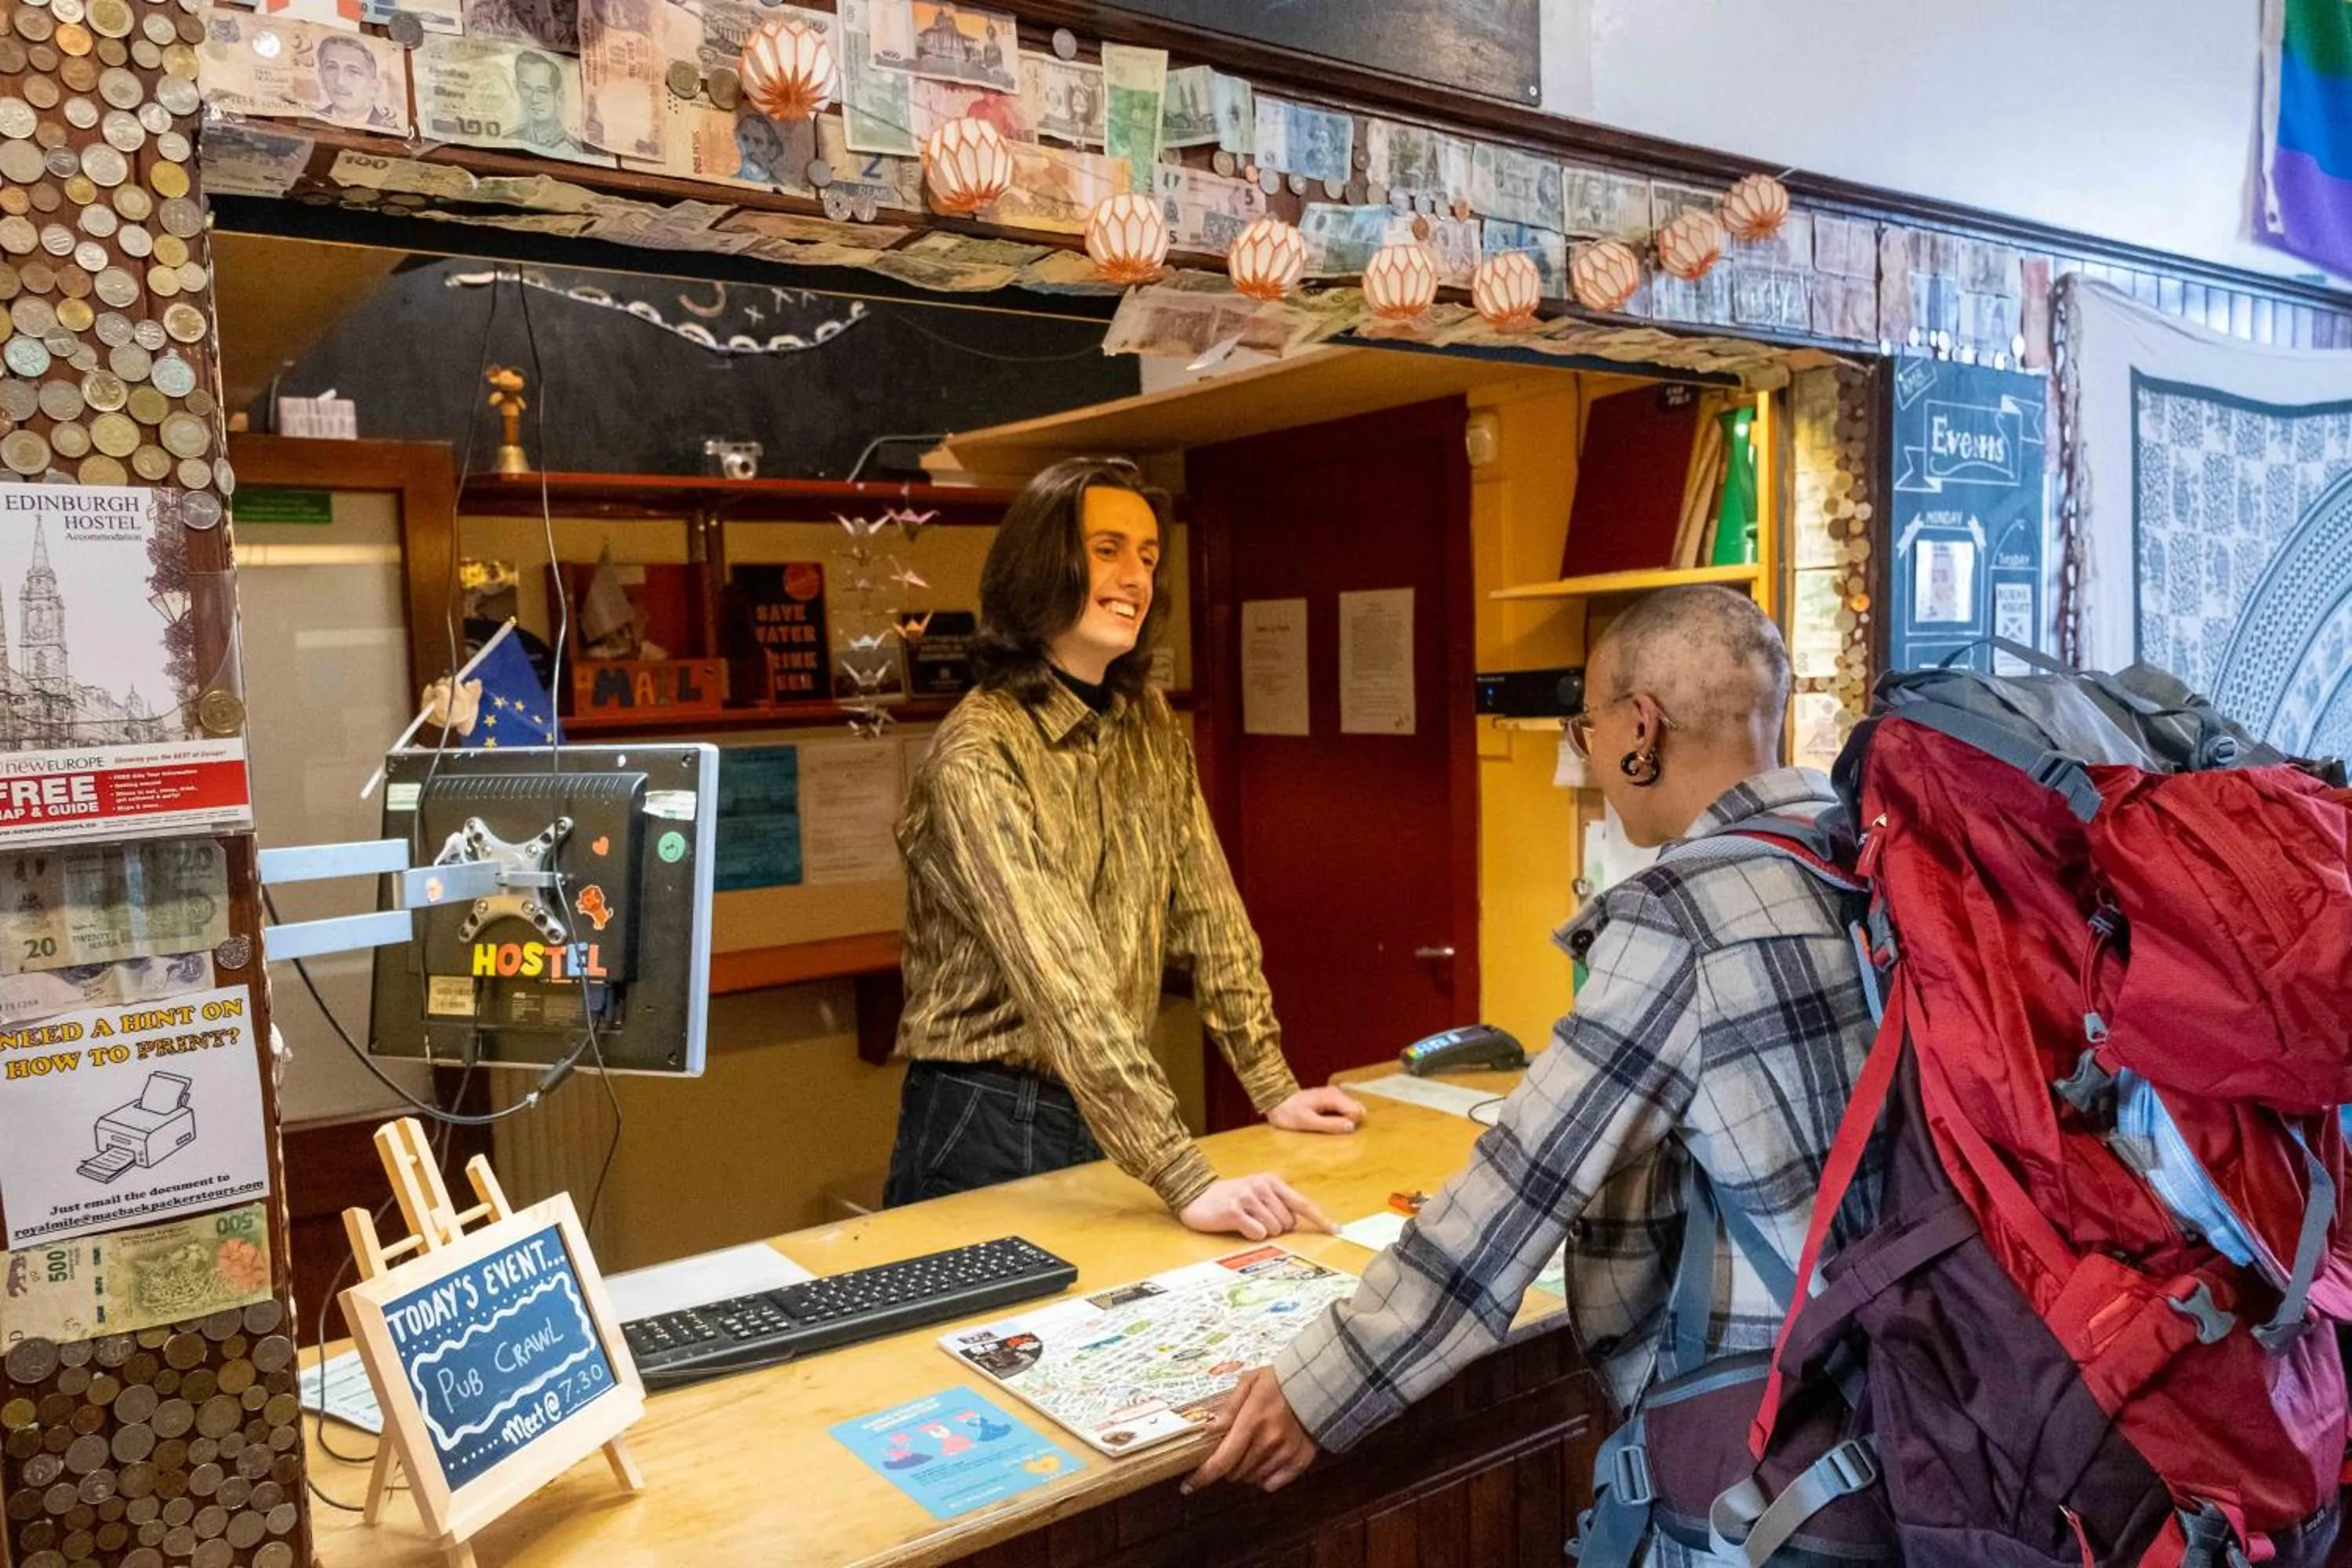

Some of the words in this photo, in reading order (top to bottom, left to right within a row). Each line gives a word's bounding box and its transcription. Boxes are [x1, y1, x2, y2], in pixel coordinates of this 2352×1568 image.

[1932, 414, 2005, 463] Events
[5, 495, 140, 512] EDINBURGH
[64, 515, 141, 530] HOSTEL
[65, 532, 142, 542] Accommodation
[757, 604, 807, 622] SAVE
[770, 652, 818, 669] RINK
[591, 666, 703, 708] MAIL
[775, 673, 814, 691] EER
[0, 809, 26, 820] AP
[31, 806, 42, 818] &
[48, 802, 100, 816] GUIDE
[24, 936, 56, 960] 20
[473, 942, 608, 979] HOSTEL
[0, 1022, 84, 1051] NEED
[91, 1018, 115, 1039] A
[120, 1005, 195, 1033] HINT
[201, 998, 244, 1021] ON
[5, 1051, 82, 1080] HOW
[88, 1044, 130, 1067] TO
[136, 1027, 241, 1059] PRINT?
[49, 1204, 82, 1216] Just
[84, 1194, 122, 1210] email
[125, 1190, 147, 1202] the
[149, 1178, 214, 1196] document
[217, 1174, 230, 1184] to
[47, 1250, 68, 1282] 500
[384, 1273, 479, 1343] TODAY'S
